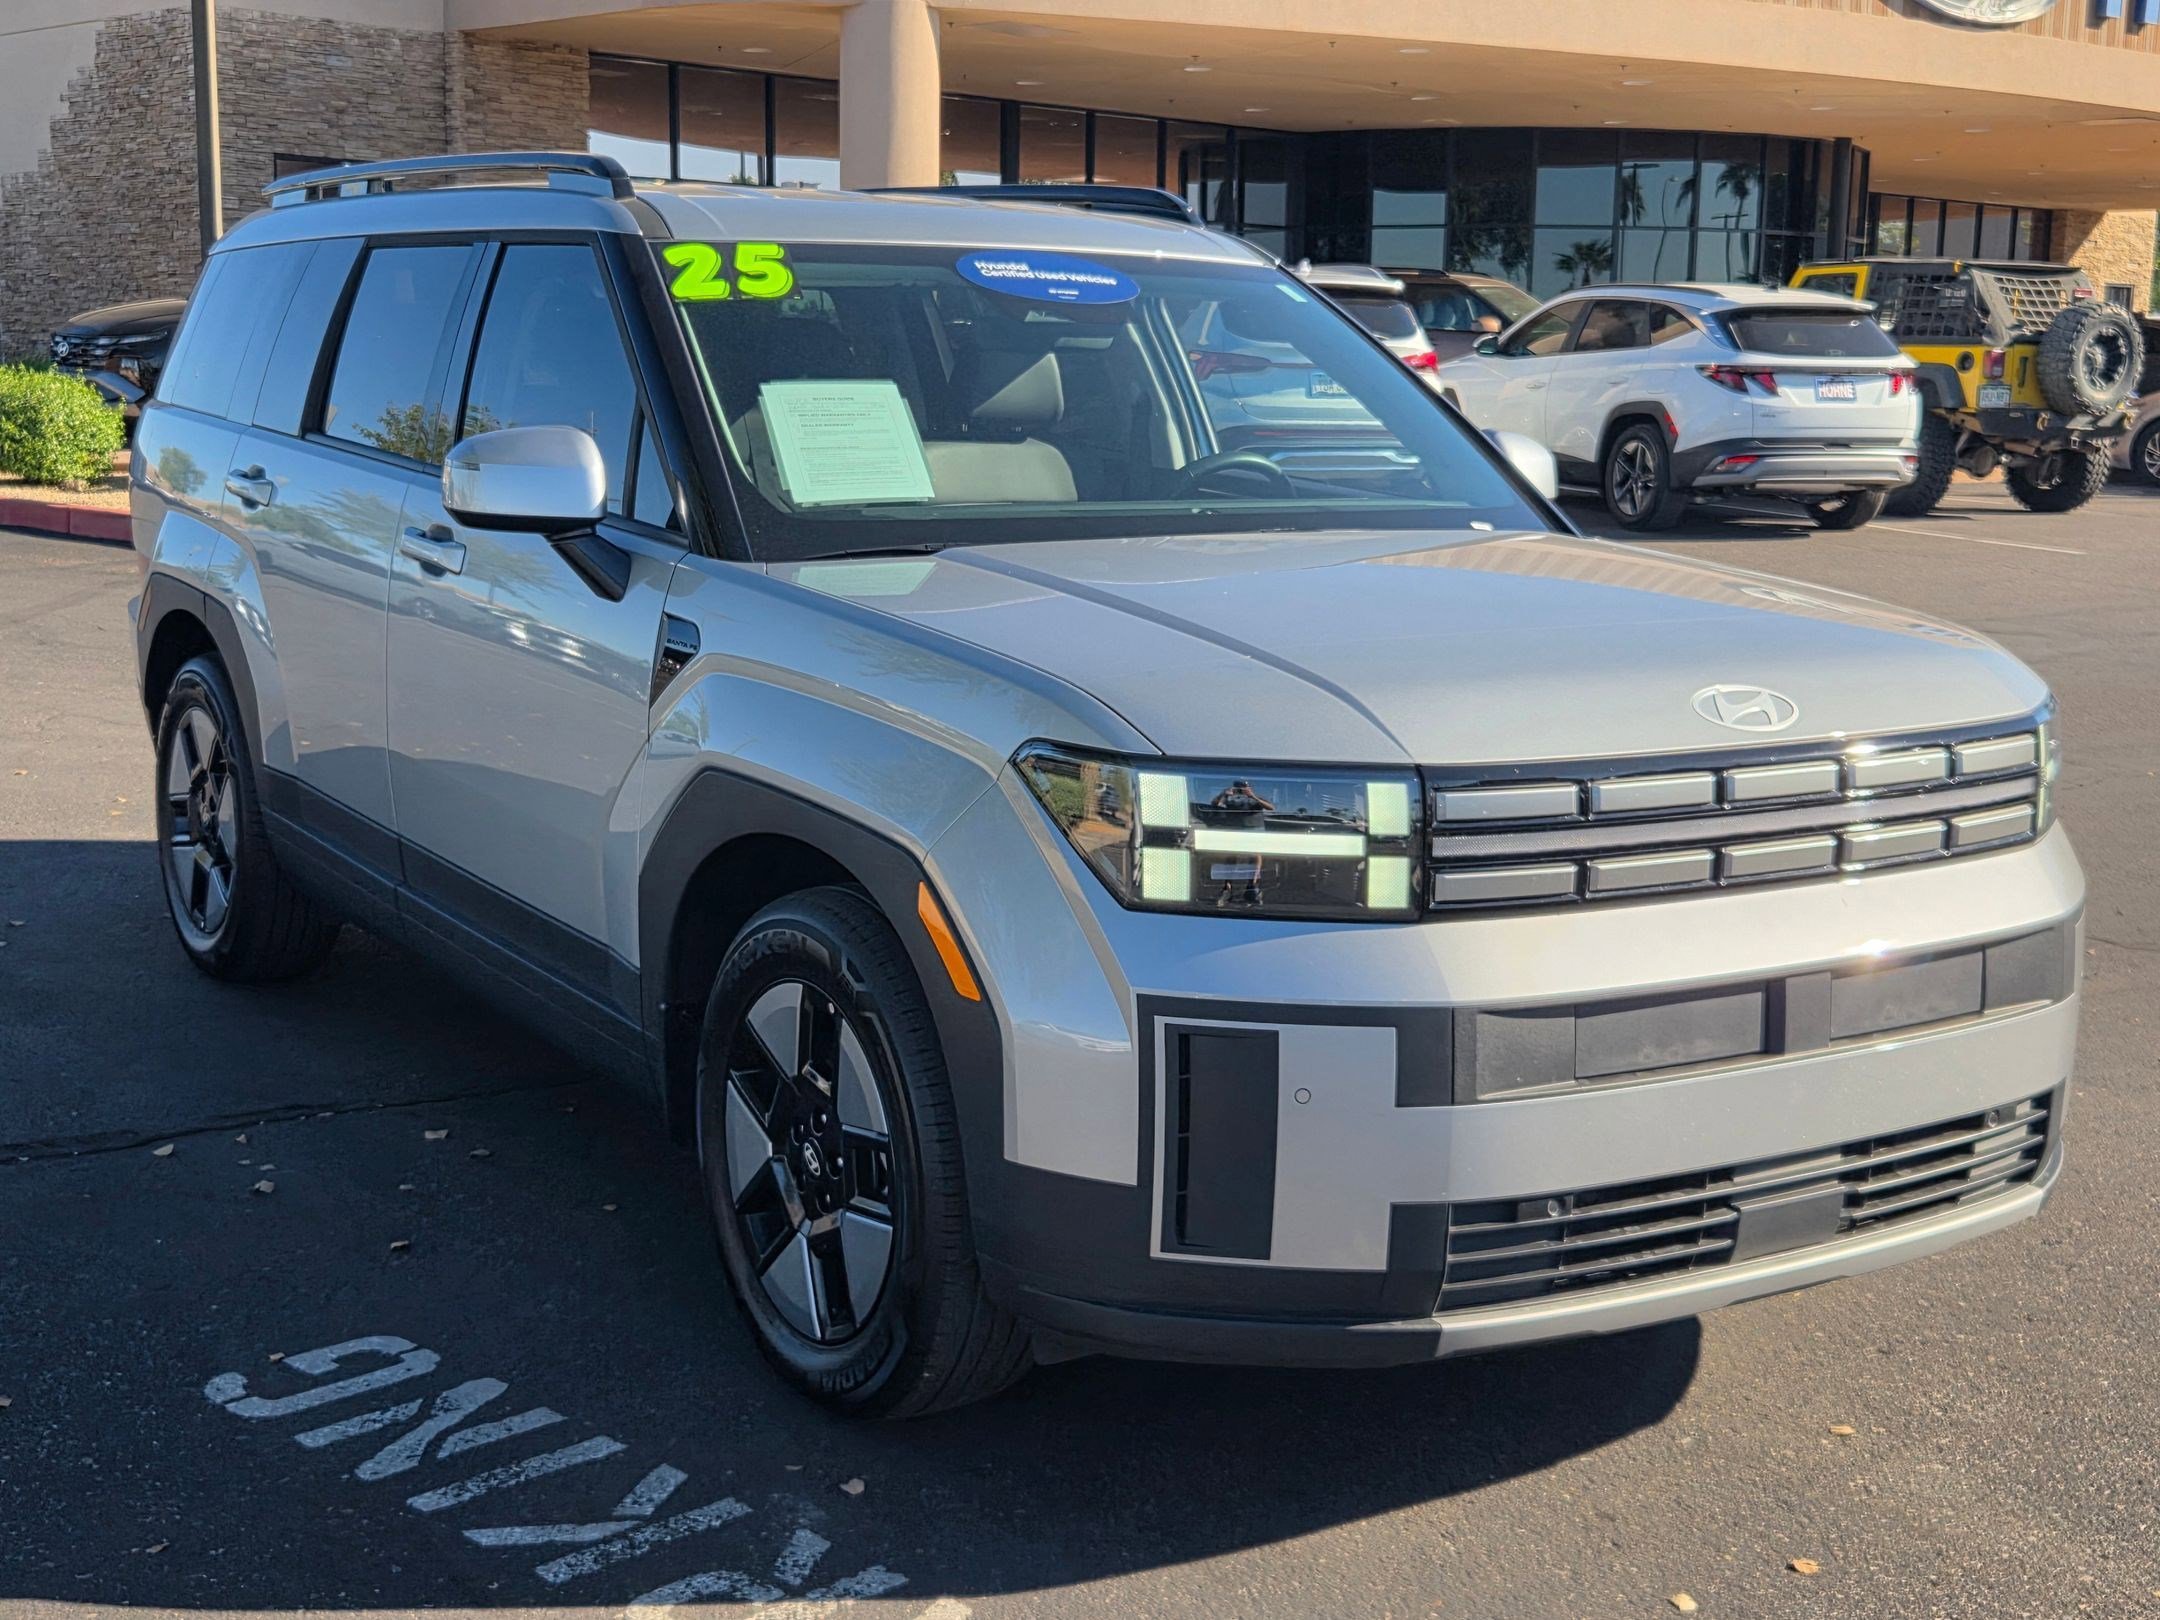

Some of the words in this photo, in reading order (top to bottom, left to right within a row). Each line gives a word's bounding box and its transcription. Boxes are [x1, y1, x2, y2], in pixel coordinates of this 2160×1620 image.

[662, 242, 793, 300] 25
[974, 260, 1029, 272] Hyundai
[981, 269, 1035, 280] Certified
[1035, 271, 1067, 281] Used
[1067, 274, 1118, 286] Vehicles
[204, 1335, 973, 1620] RKING
